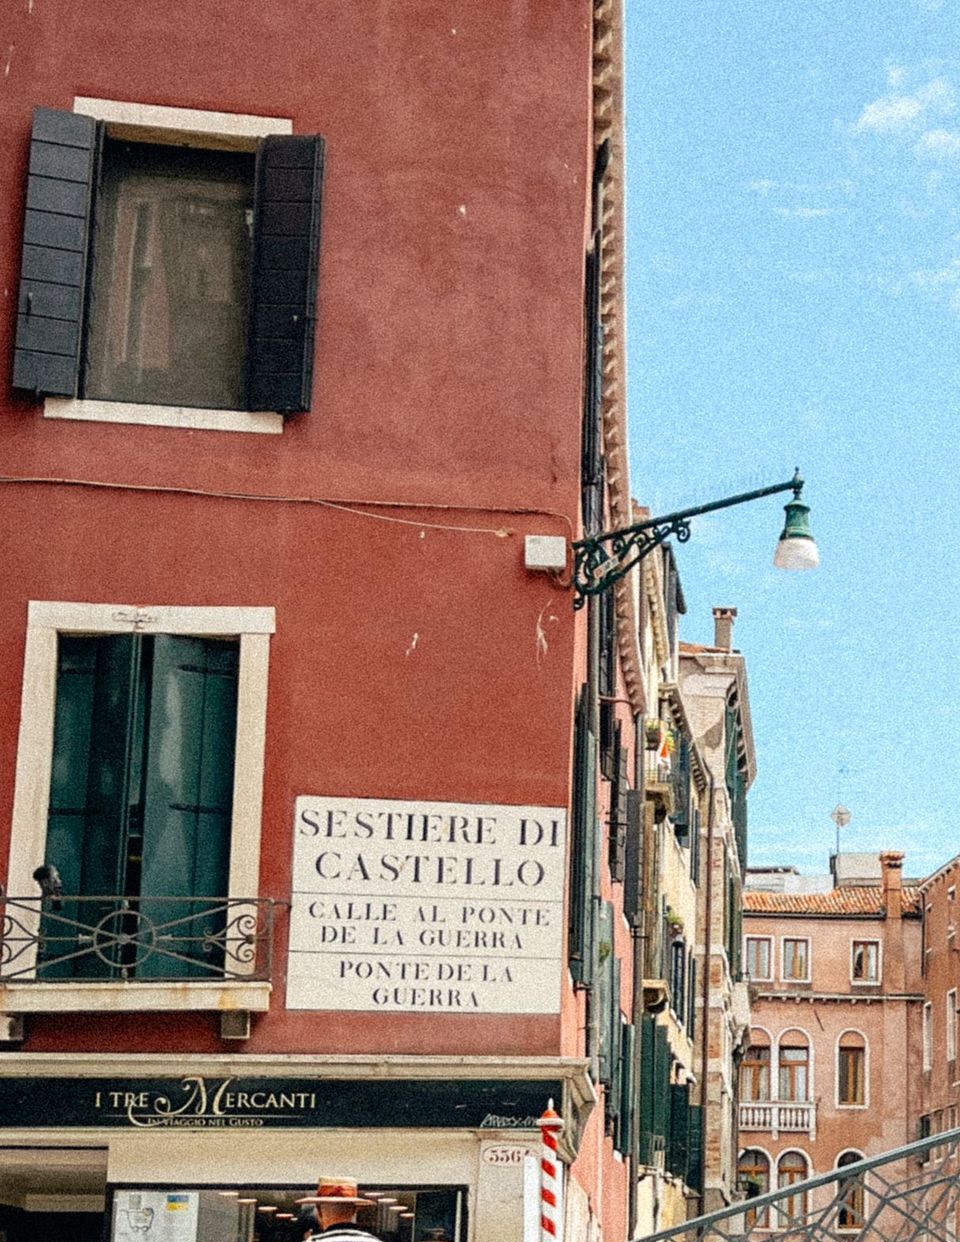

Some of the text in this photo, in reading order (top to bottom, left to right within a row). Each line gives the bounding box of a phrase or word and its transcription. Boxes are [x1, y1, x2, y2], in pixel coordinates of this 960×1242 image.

[300, 809, 560, 847] SESTIERE DI
[315, 851, 546, 887] CASTELLO
[309, 901, 551, 926] CALLE AL PONTE
[321, 925, 523, 949] DE LA GUERRA
[339, 960, 513, 983] PONTE DE LA
[372, 987, 479, 1008] GUERRA
[95, 1091, 102, 1108] I
